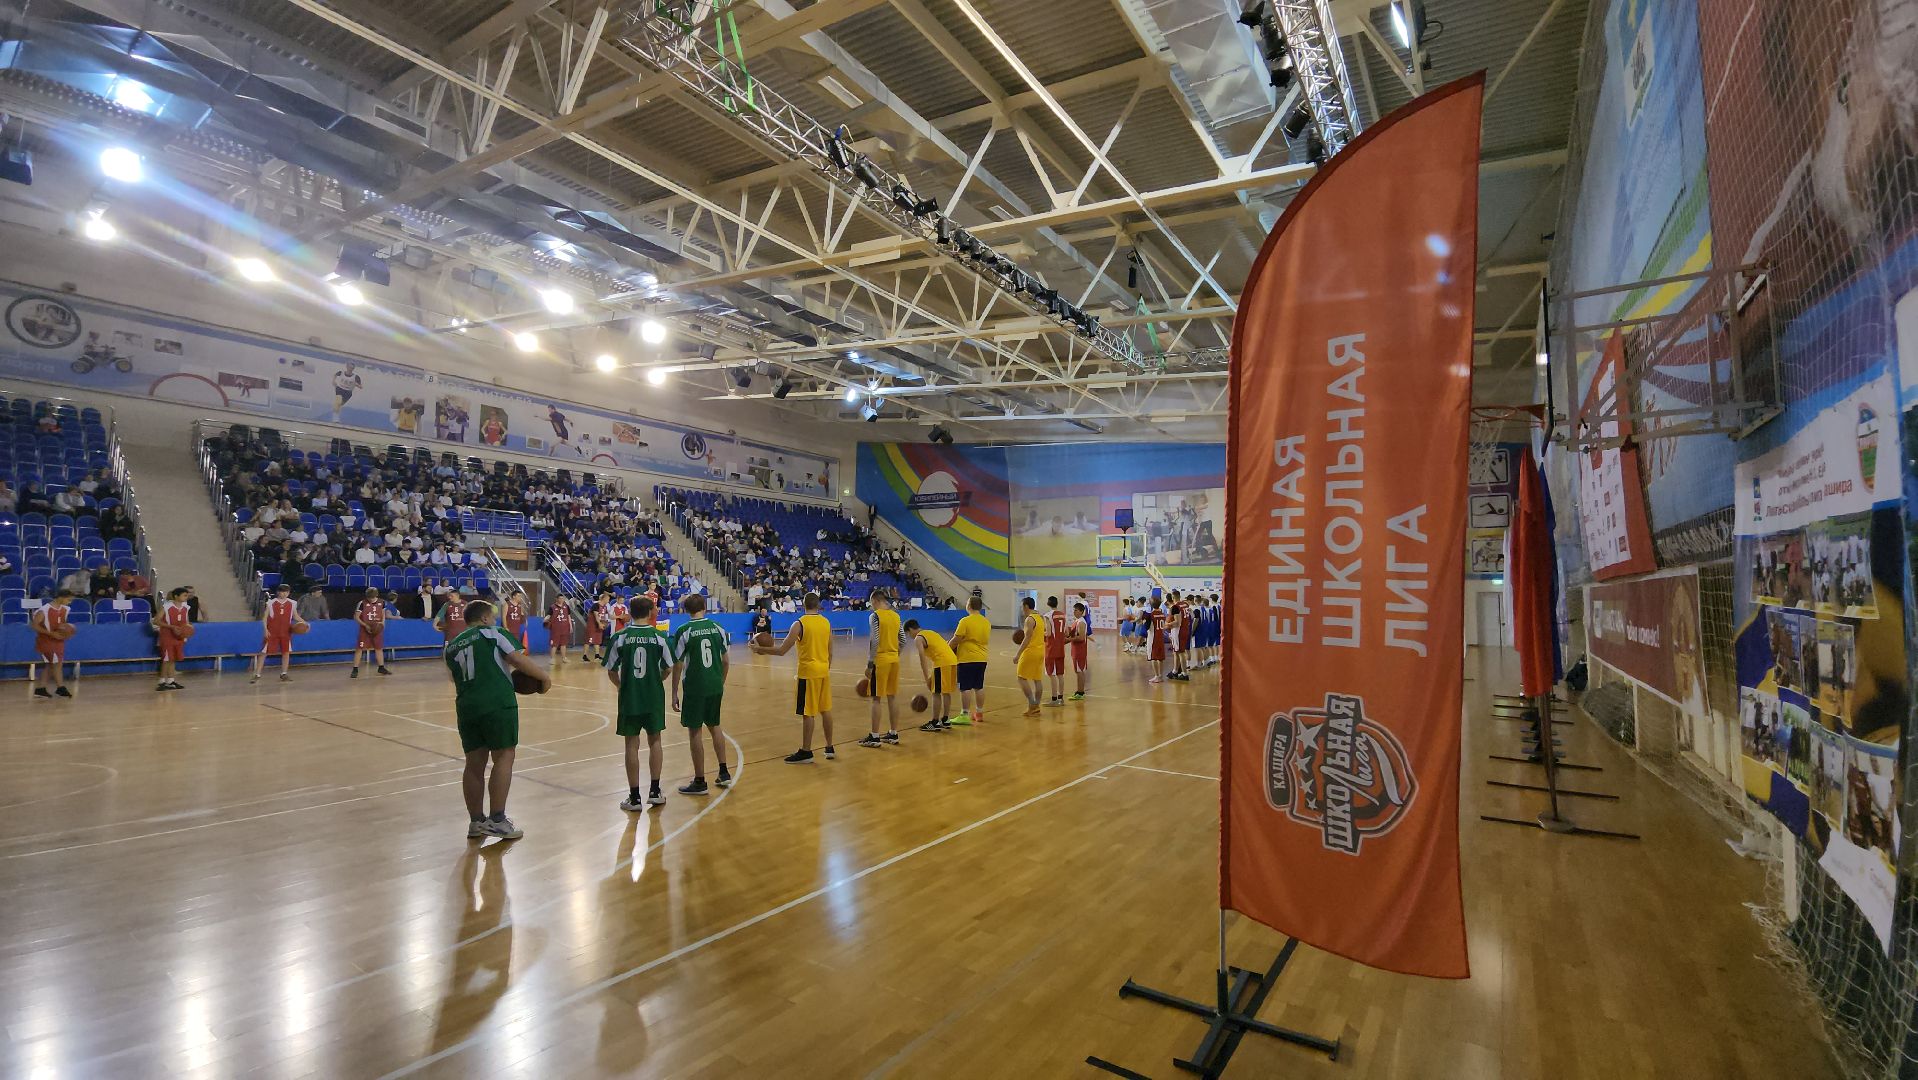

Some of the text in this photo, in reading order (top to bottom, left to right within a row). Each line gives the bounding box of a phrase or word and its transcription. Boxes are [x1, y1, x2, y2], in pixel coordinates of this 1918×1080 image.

[1268, 434, 1312, 644] ЕДИНАЯ
[1321, 333, 1366, 649] ШКОЛЬНАЯ
[1058, 619, 1064, 633] 7
[1384, 504, 1429, 658] ЛИГА
[633, 646, 647, 679] 9
[700, 638, 713, 668] 6
[1272, 733, 1288, 789] КАШИРА
[1324, 699, 1357, 849] ШКОЛЬНАЯ
